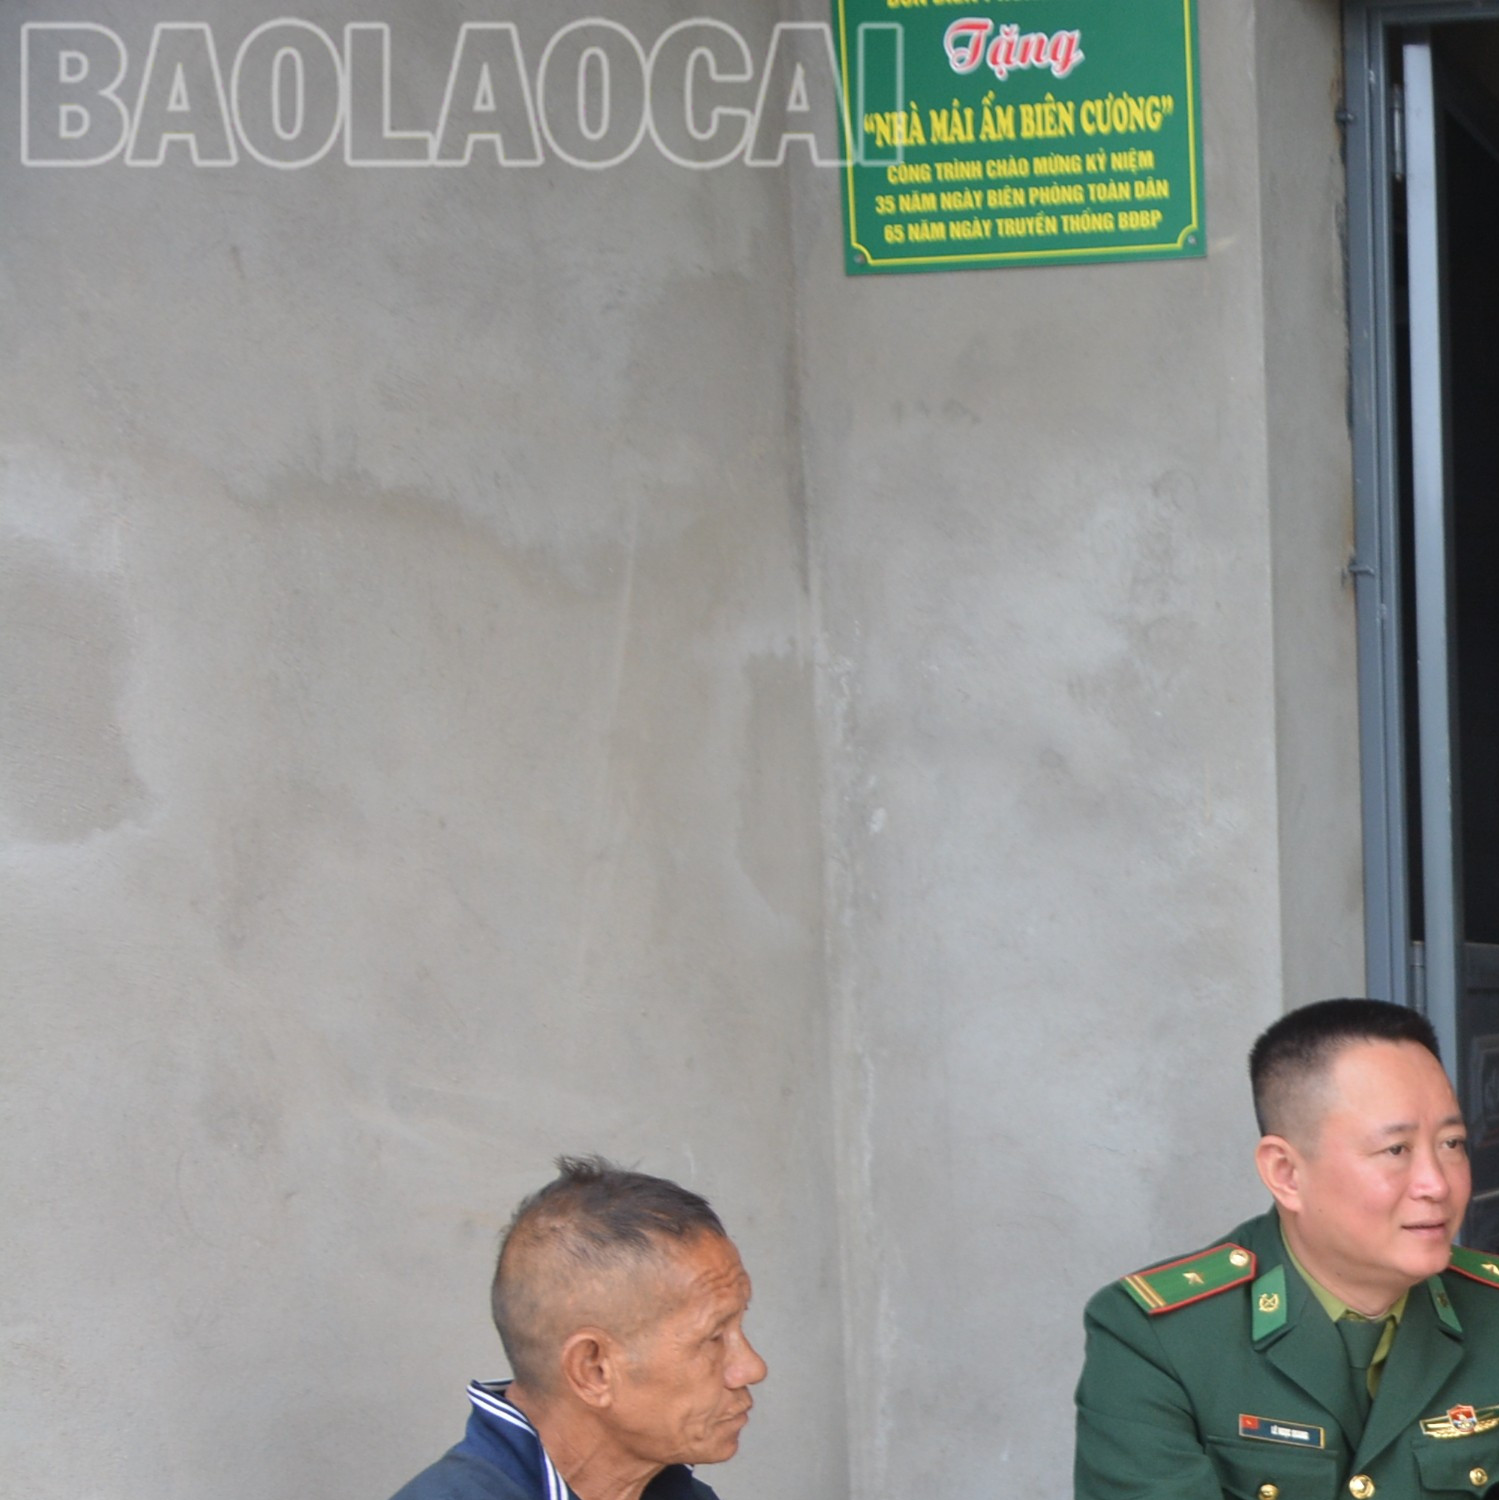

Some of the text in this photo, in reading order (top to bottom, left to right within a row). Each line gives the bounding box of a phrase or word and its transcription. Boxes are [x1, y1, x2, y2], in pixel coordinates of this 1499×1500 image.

[943, 17, 1085, 80] Tặng
[979, 90, 1016, 142] ẤM
[1019, 92, 1075, 141] BIÊN
[887, 161, 932, 184] CÔNG
[935, 158, 983, 182] TRÌNH
[986, 155, 1029, 179] CHÀO
[1033, 152, 1082, 176] MỪNG
[1111, 147, 1155, 174] NIỆM
[875, 176, 1170, 215] 35 NĂM NGÀY BIÊN PHÒNG TOÀN DÂN
[884, 208, 1163, 244] 65 NĂM NGÀY TRUYỀN THỐNG BĐBP
